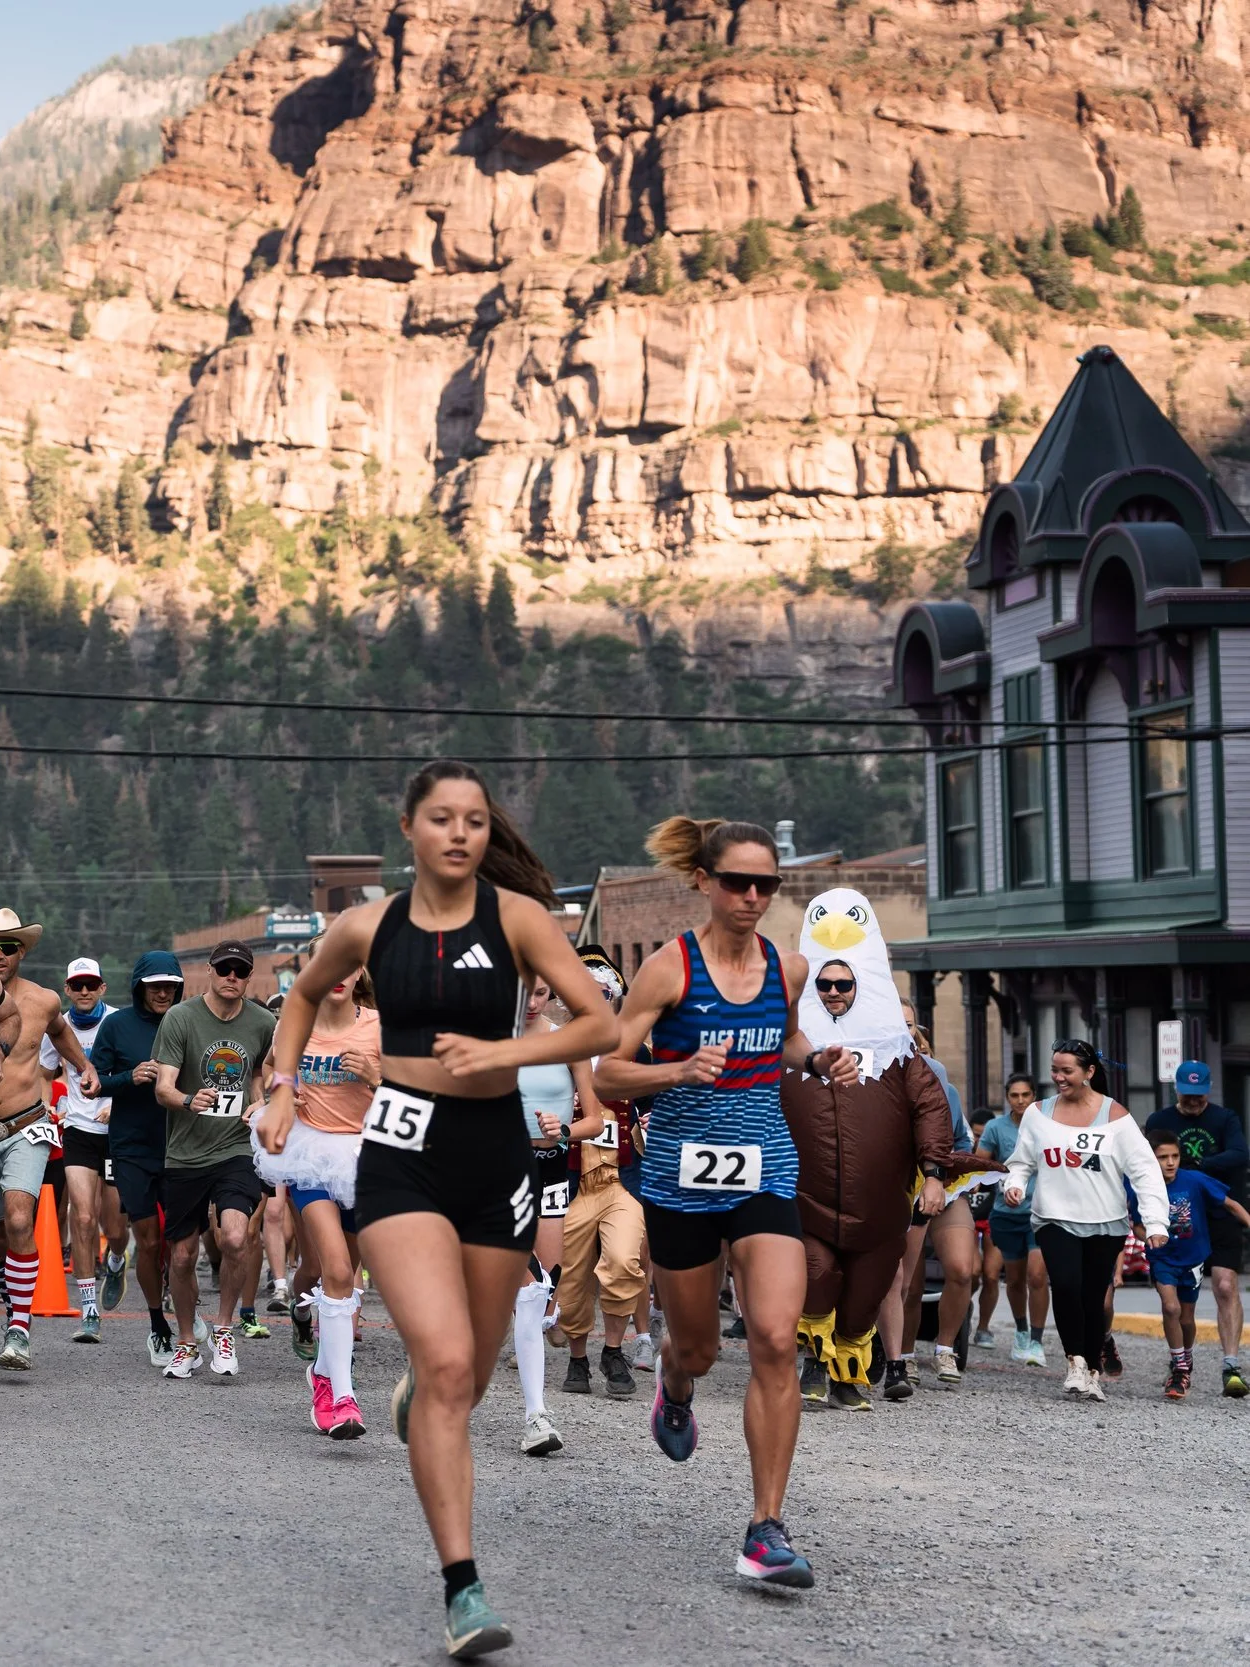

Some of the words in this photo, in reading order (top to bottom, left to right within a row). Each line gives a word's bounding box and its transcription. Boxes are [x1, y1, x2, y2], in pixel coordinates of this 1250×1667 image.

[206, 1041, 223, 1055] THREE
[227, 1041, 247, 1059] RIVERS
[737, 1028, 782, 1052] FILLIES
[1188, 1073, 1199, 1083] C
[364, 1100, 422, 1141] 15
[1076, 1133, 1106, 1152] 87
[533, 1149, 558, 1160] RO
[1043, 1147, 1102, 1173] USA
[693, 1150, 747, 1186] 22
